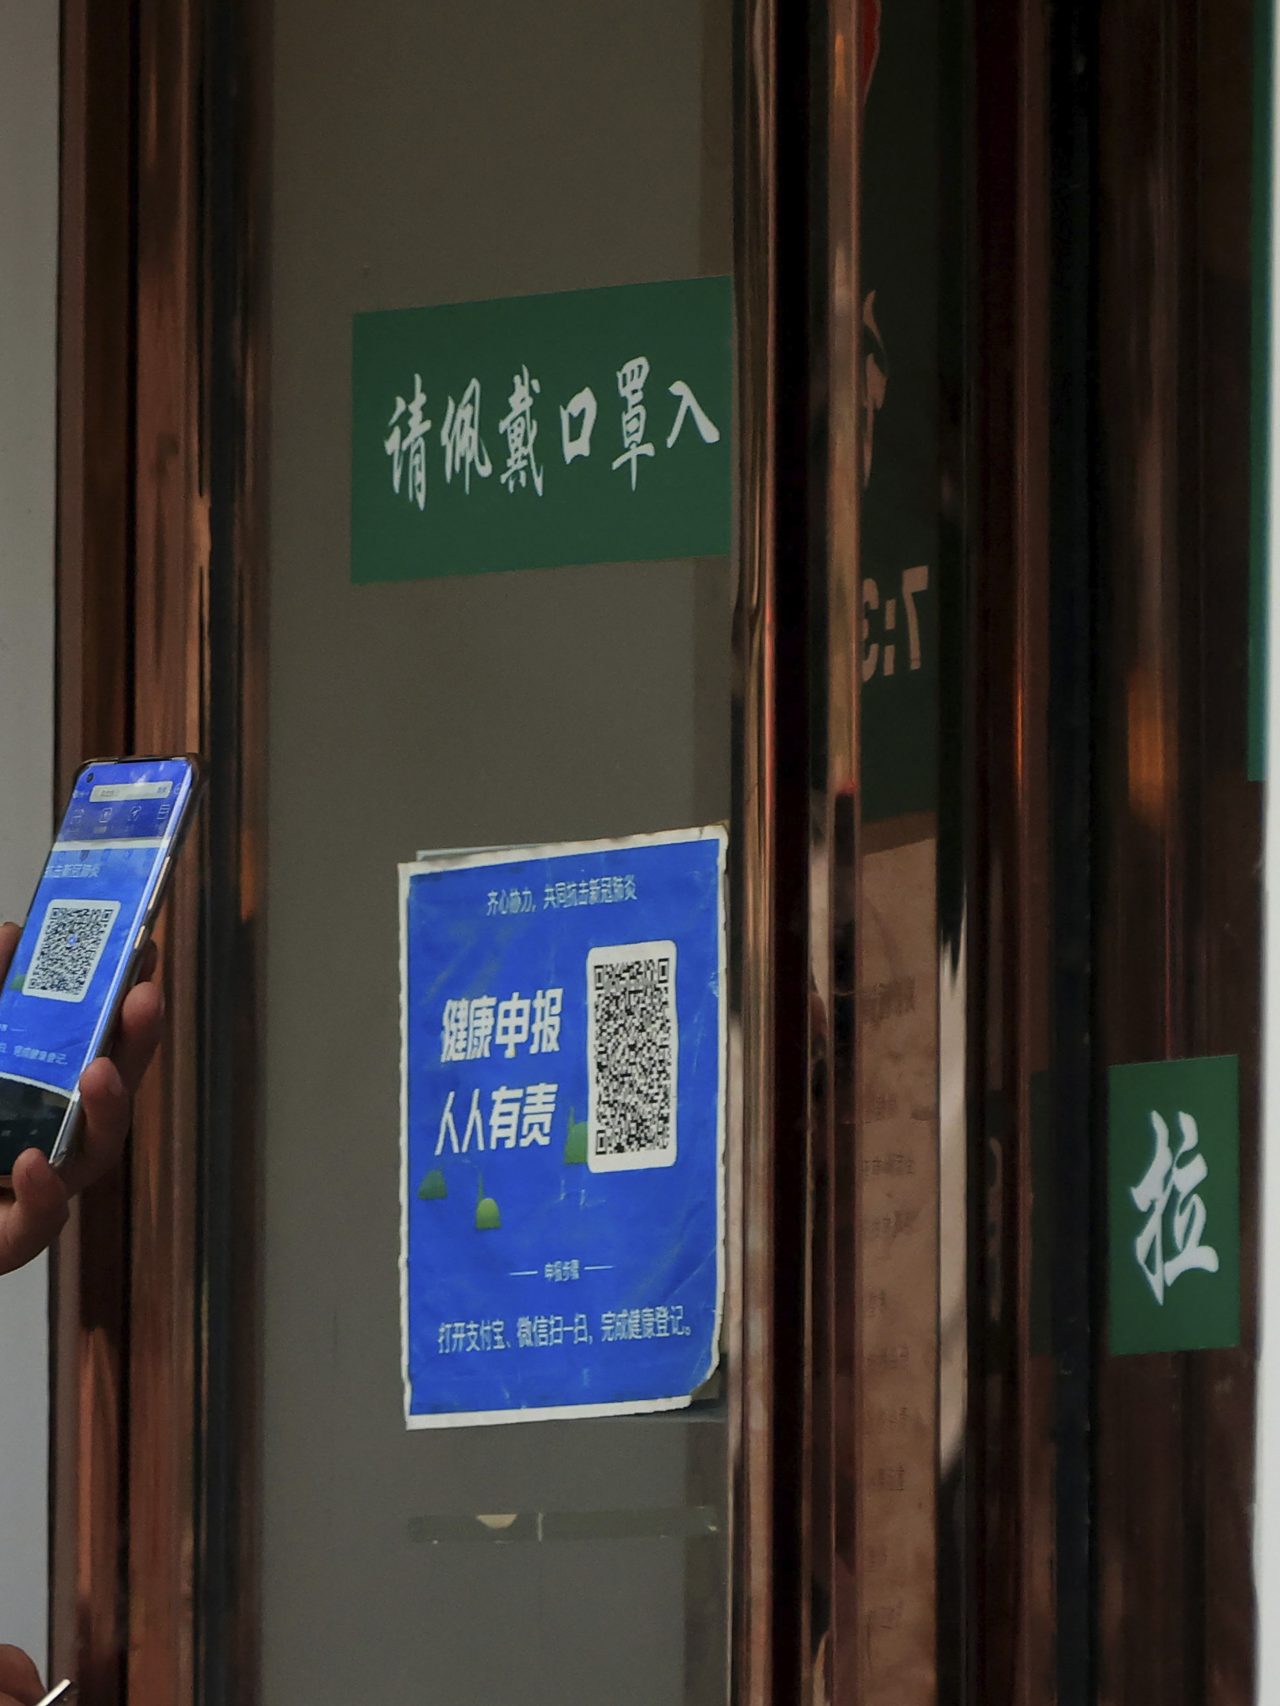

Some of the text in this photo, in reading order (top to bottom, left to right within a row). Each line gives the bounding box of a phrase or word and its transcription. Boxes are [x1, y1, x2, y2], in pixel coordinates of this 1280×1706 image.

[384, 356, 721, 512] 请佩戴口罩入
[440, 988, 564, 1063] 健康申报
[435, 1083, 559, 1156] 人人有责
[1130, 1110, 1220, 1306] 拉
